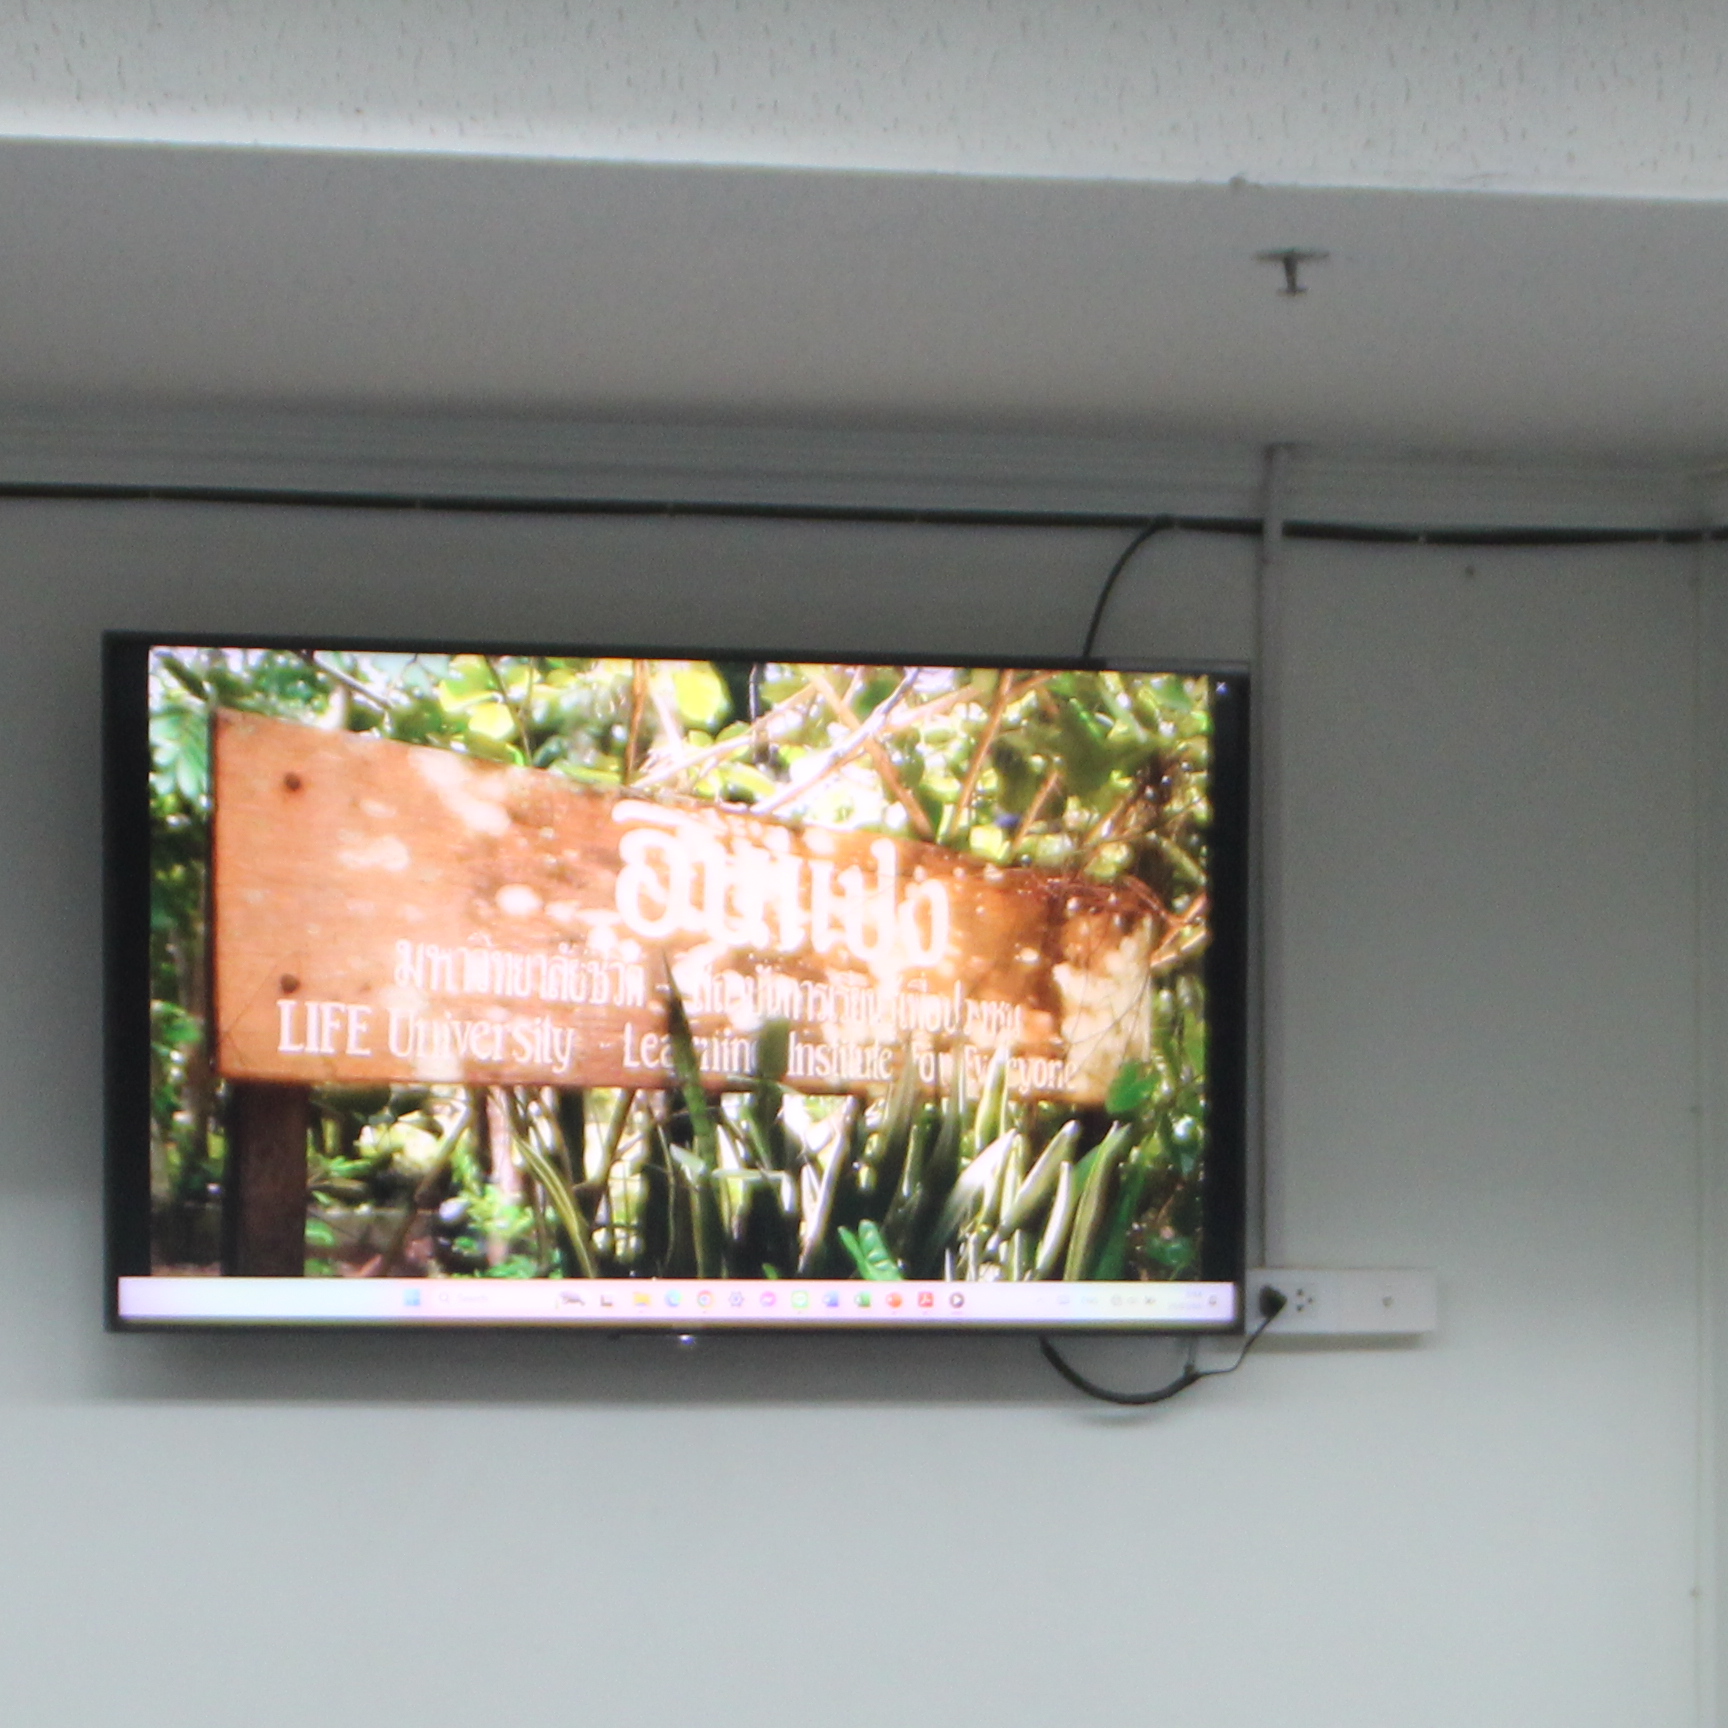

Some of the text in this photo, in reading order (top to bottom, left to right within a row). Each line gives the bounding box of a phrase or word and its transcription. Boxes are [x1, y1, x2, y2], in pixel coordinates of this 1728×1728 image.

[276, 998, 373, 1057] LIFE
[386, 1003, 575, 1073] University
[622, 1021, 760, 1077] Leanin
